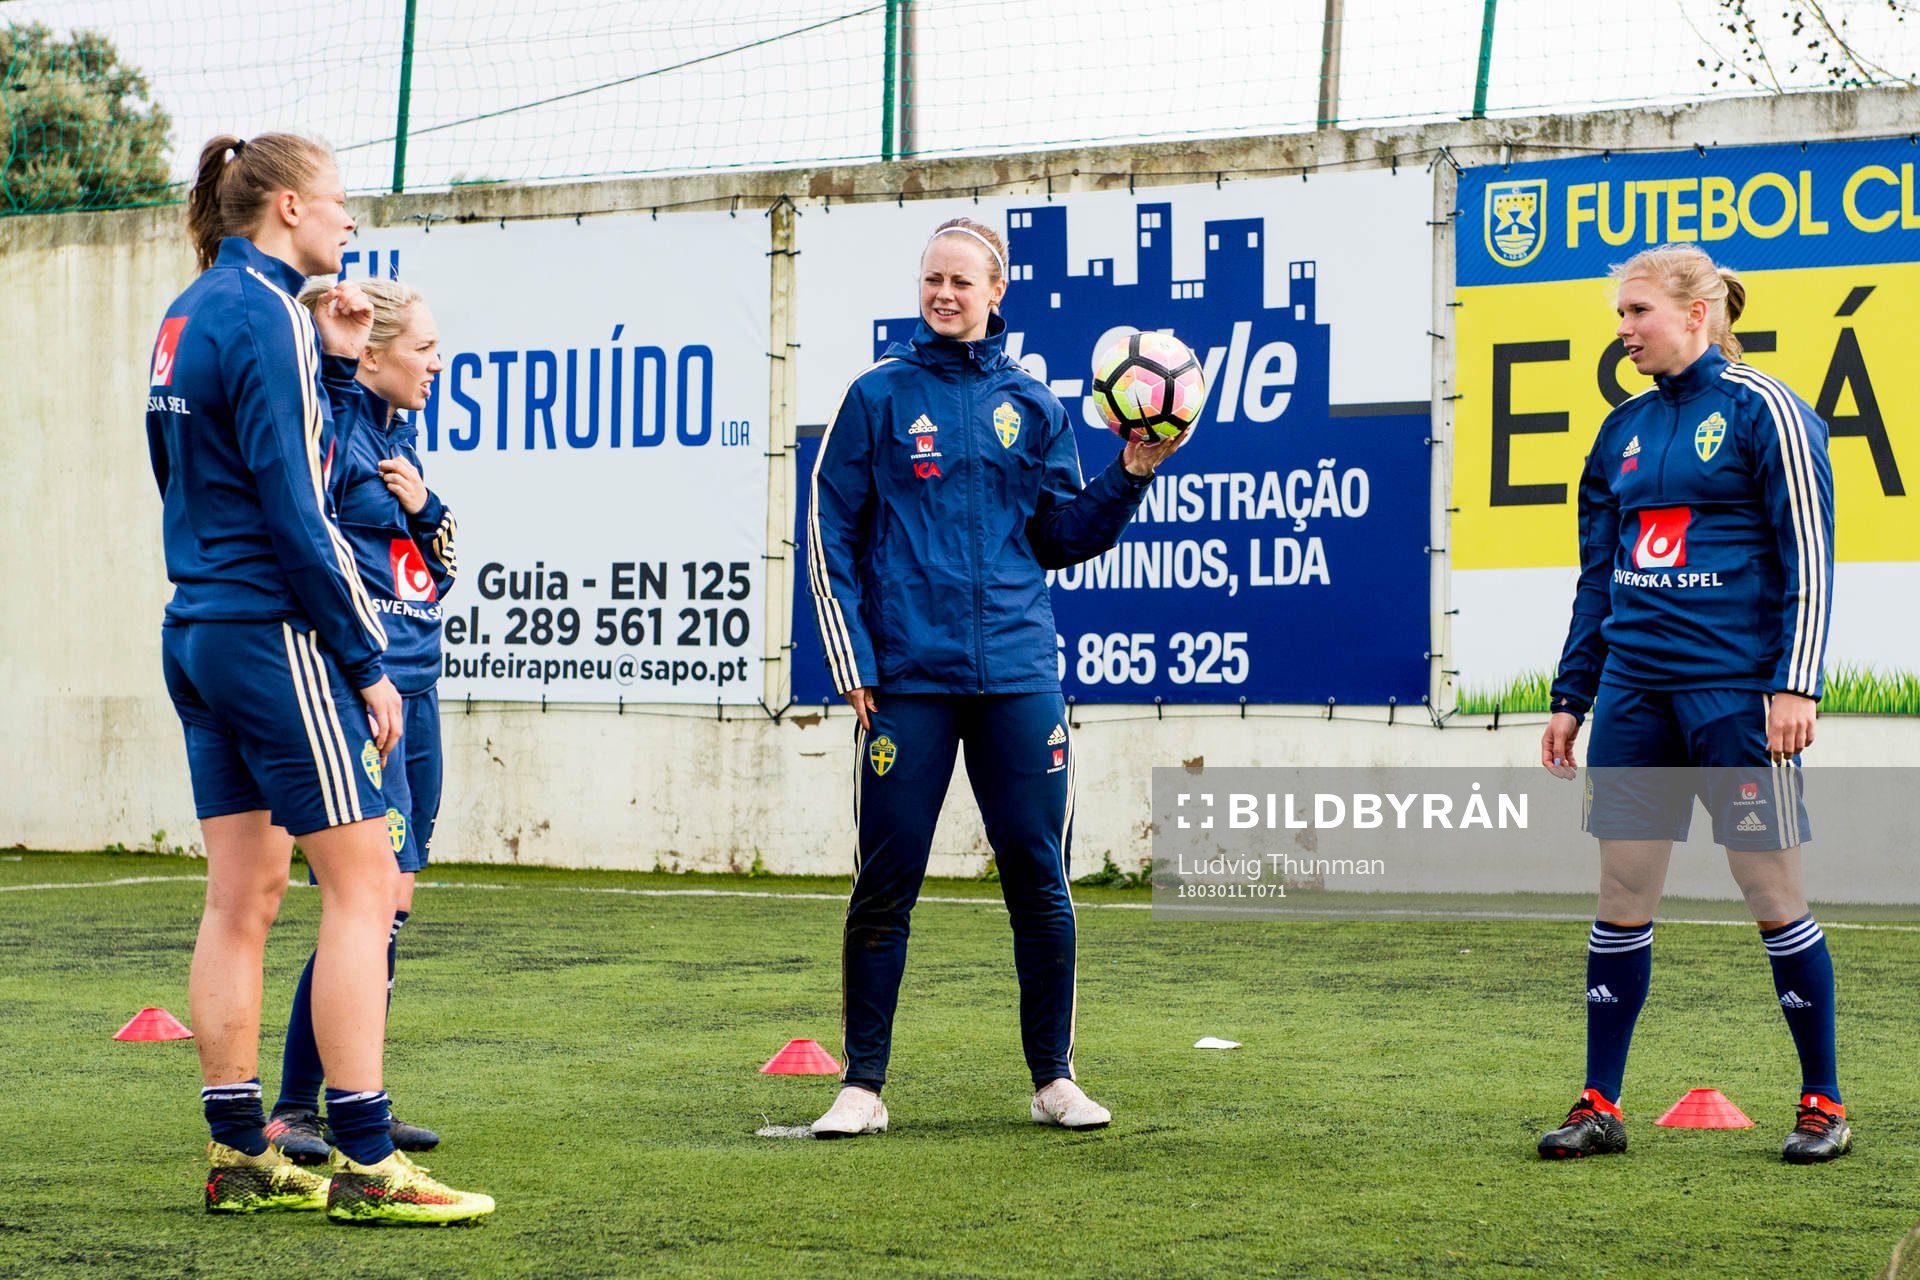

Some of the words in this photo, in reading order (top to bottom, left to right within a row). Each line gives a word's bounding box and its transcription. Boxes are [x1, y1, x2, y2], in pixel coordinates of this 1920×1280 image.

[1566, 172, 1829, 249] FUTEBOL
[1842, 163, 1920, 233] CL
[721, 421, 750, 447] LDA
[908, 425, 938, 435] adidas
[913, 461, 942, 479] ICA
[1130, 458, 1370, 532] NISTRAÇÃO
[477, 561, 569, 601] Guia
[611, 561, 668, 601] EN
[682, 561, 751, 601] 125
[1249, 536, 1331, 586] LDA
[1613, 568, 1673, 588] SVENSKA
[1677, 572, 1724, 588] SPEL
[440, 606, 491, 646] el.
[504, 607, 581, 646] 289
[594, 607, 663, 647] 561
[677, 607, 751, 648] 210
[1076, 631, 1157, 685] 865
[1168, 631, 1250, 685] 325
